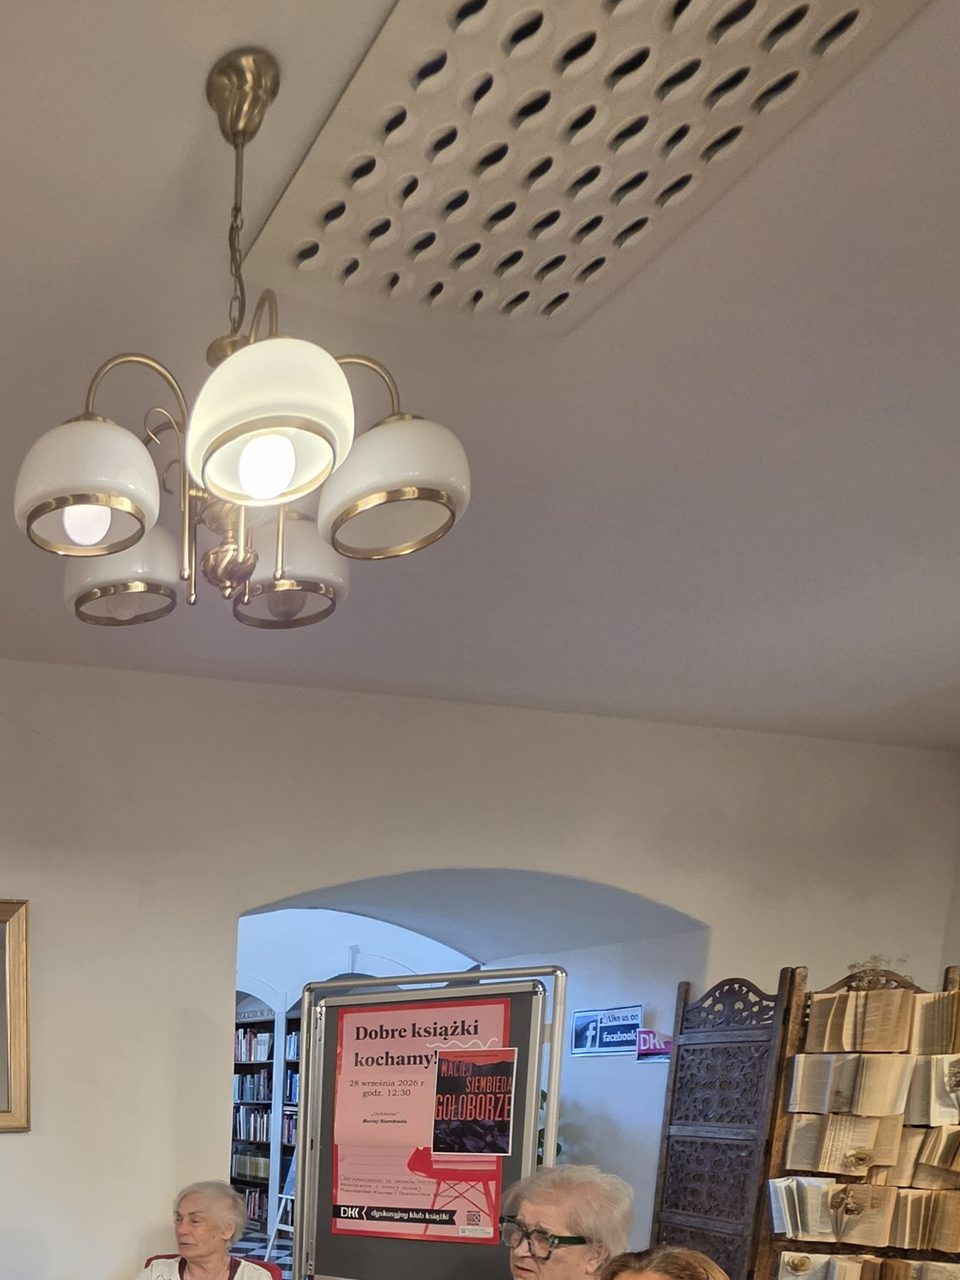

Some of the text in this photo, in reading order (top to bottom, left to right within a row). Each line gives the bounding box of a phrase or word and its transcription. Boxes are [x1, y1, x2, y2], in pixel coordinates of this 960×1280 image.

[608, 1014, 620, 1022] Like
[355, 1019, 479, 1041] Dobre książki
[602, 1029, 637, 1043] facebook
[353, 1050, 438, 1069] kochamy!
[441, 1060, 473, 1078] MACIEJ
[349, 1079, 359, 1087] 28
[361, 1079, 395, 1087] września
[398, 1079, 419, 1087] 2026
[465, 1076, 513, 1093] SIEMBIEDA
[362, 1089, 411, 1098] godz. 12:30
[435, 1094, 513, 1121] GOŁOBORZE
[409, 1211, 424, 1219] klub
